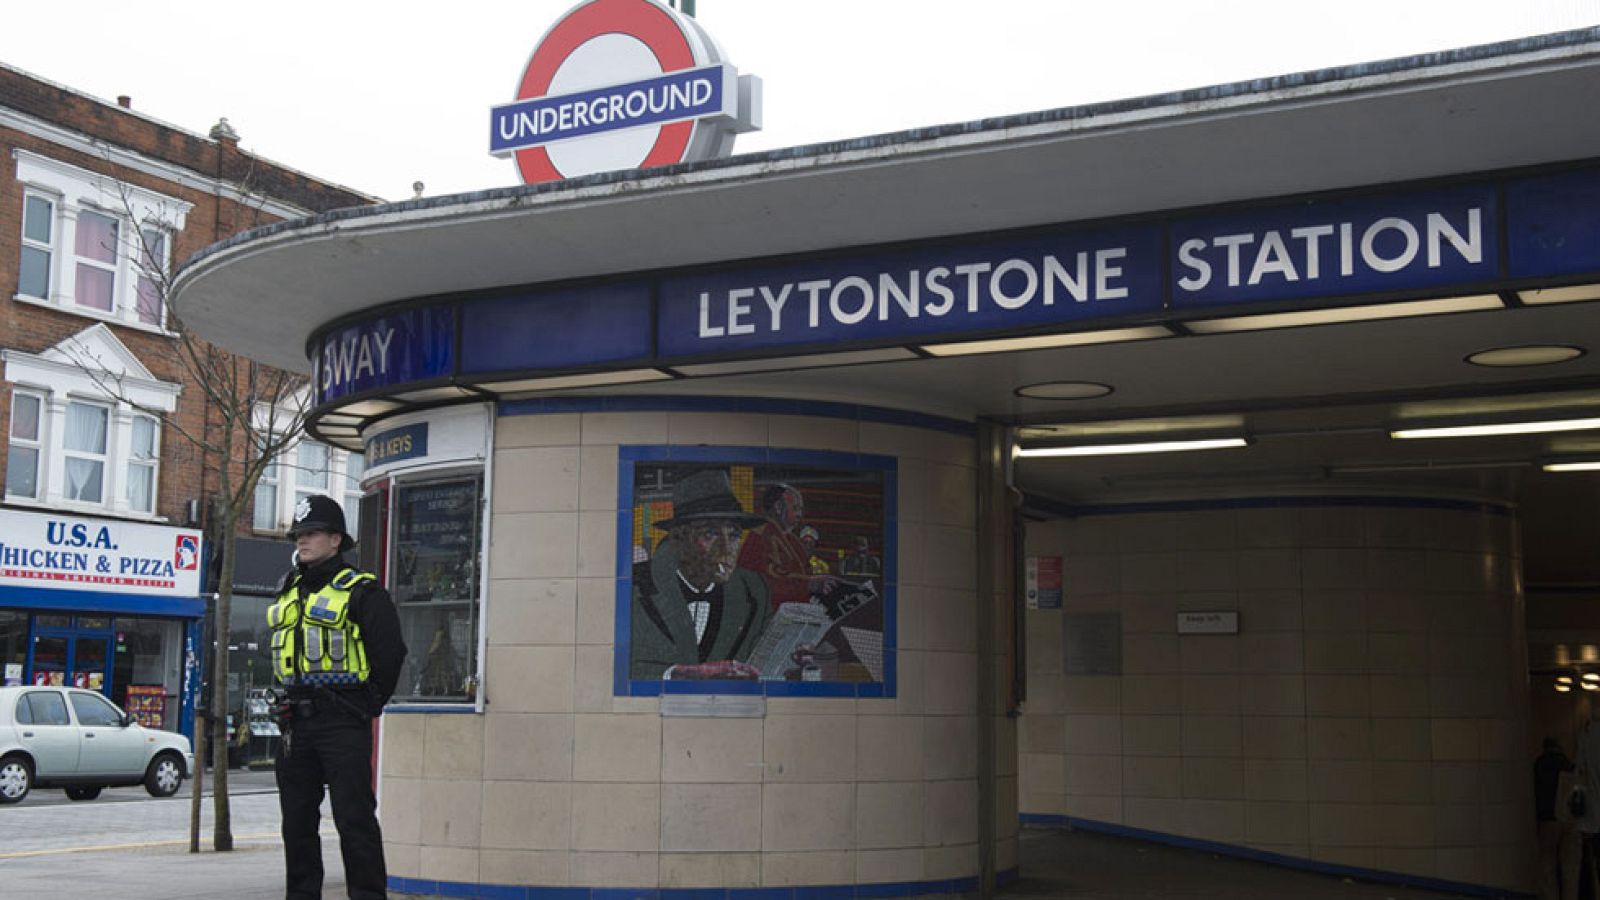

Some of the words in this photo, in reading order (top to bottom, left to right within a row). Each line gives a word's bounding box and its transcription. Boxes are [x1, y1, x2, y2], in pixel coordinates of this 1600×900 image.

[500, 79, 712, 140] UNDERGROUND
[699, 248, 1128, 338] LEYTONSTONE
[1177, 208, 1482, 291] STATION
[387, 433, 412, 456] KEYS
[47, 522, 118, 550] U.S.A.
[96, 555, 111, 573] &
[119, 557, 175, 577] PIZZA
